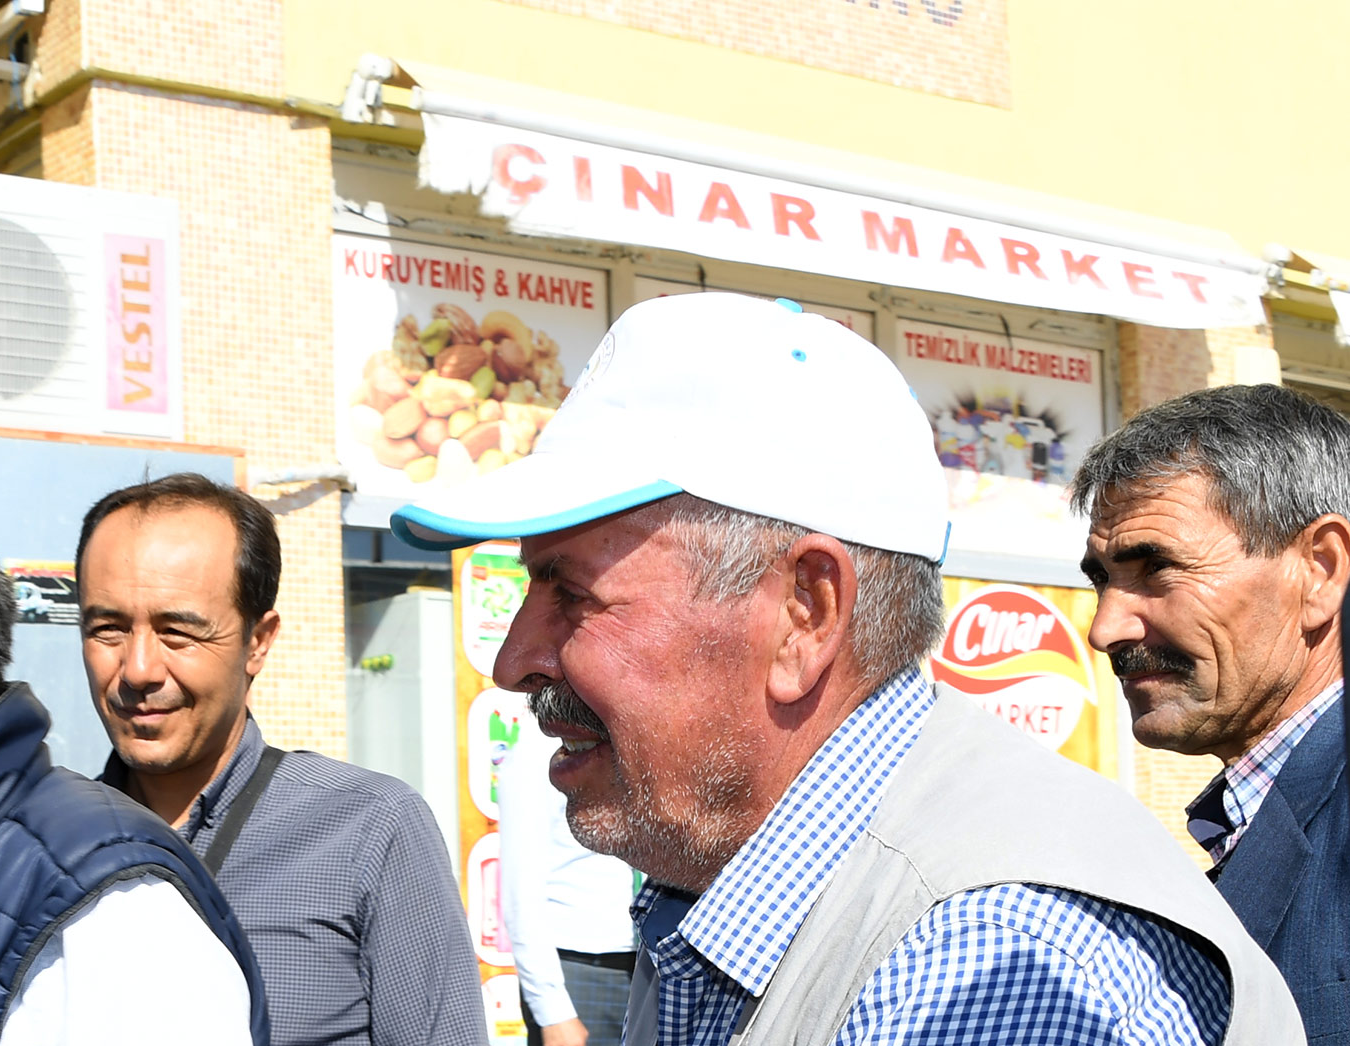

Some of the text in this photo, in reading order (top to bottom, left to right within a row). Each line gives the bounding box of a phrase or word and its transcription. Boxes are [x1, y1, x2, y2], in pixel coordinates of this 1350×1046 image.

[490, 143, 1210, 305] ÇINAR MARKET
[344, 248, 595, 310] KURUYEMİŞ & KAHVE
[119, 243, 154, 406] VESTEL
[903, 330, 1093, 385] TEMİZLİK MALZEMELERİ
[982, 702, 1064, 734] ARKET
